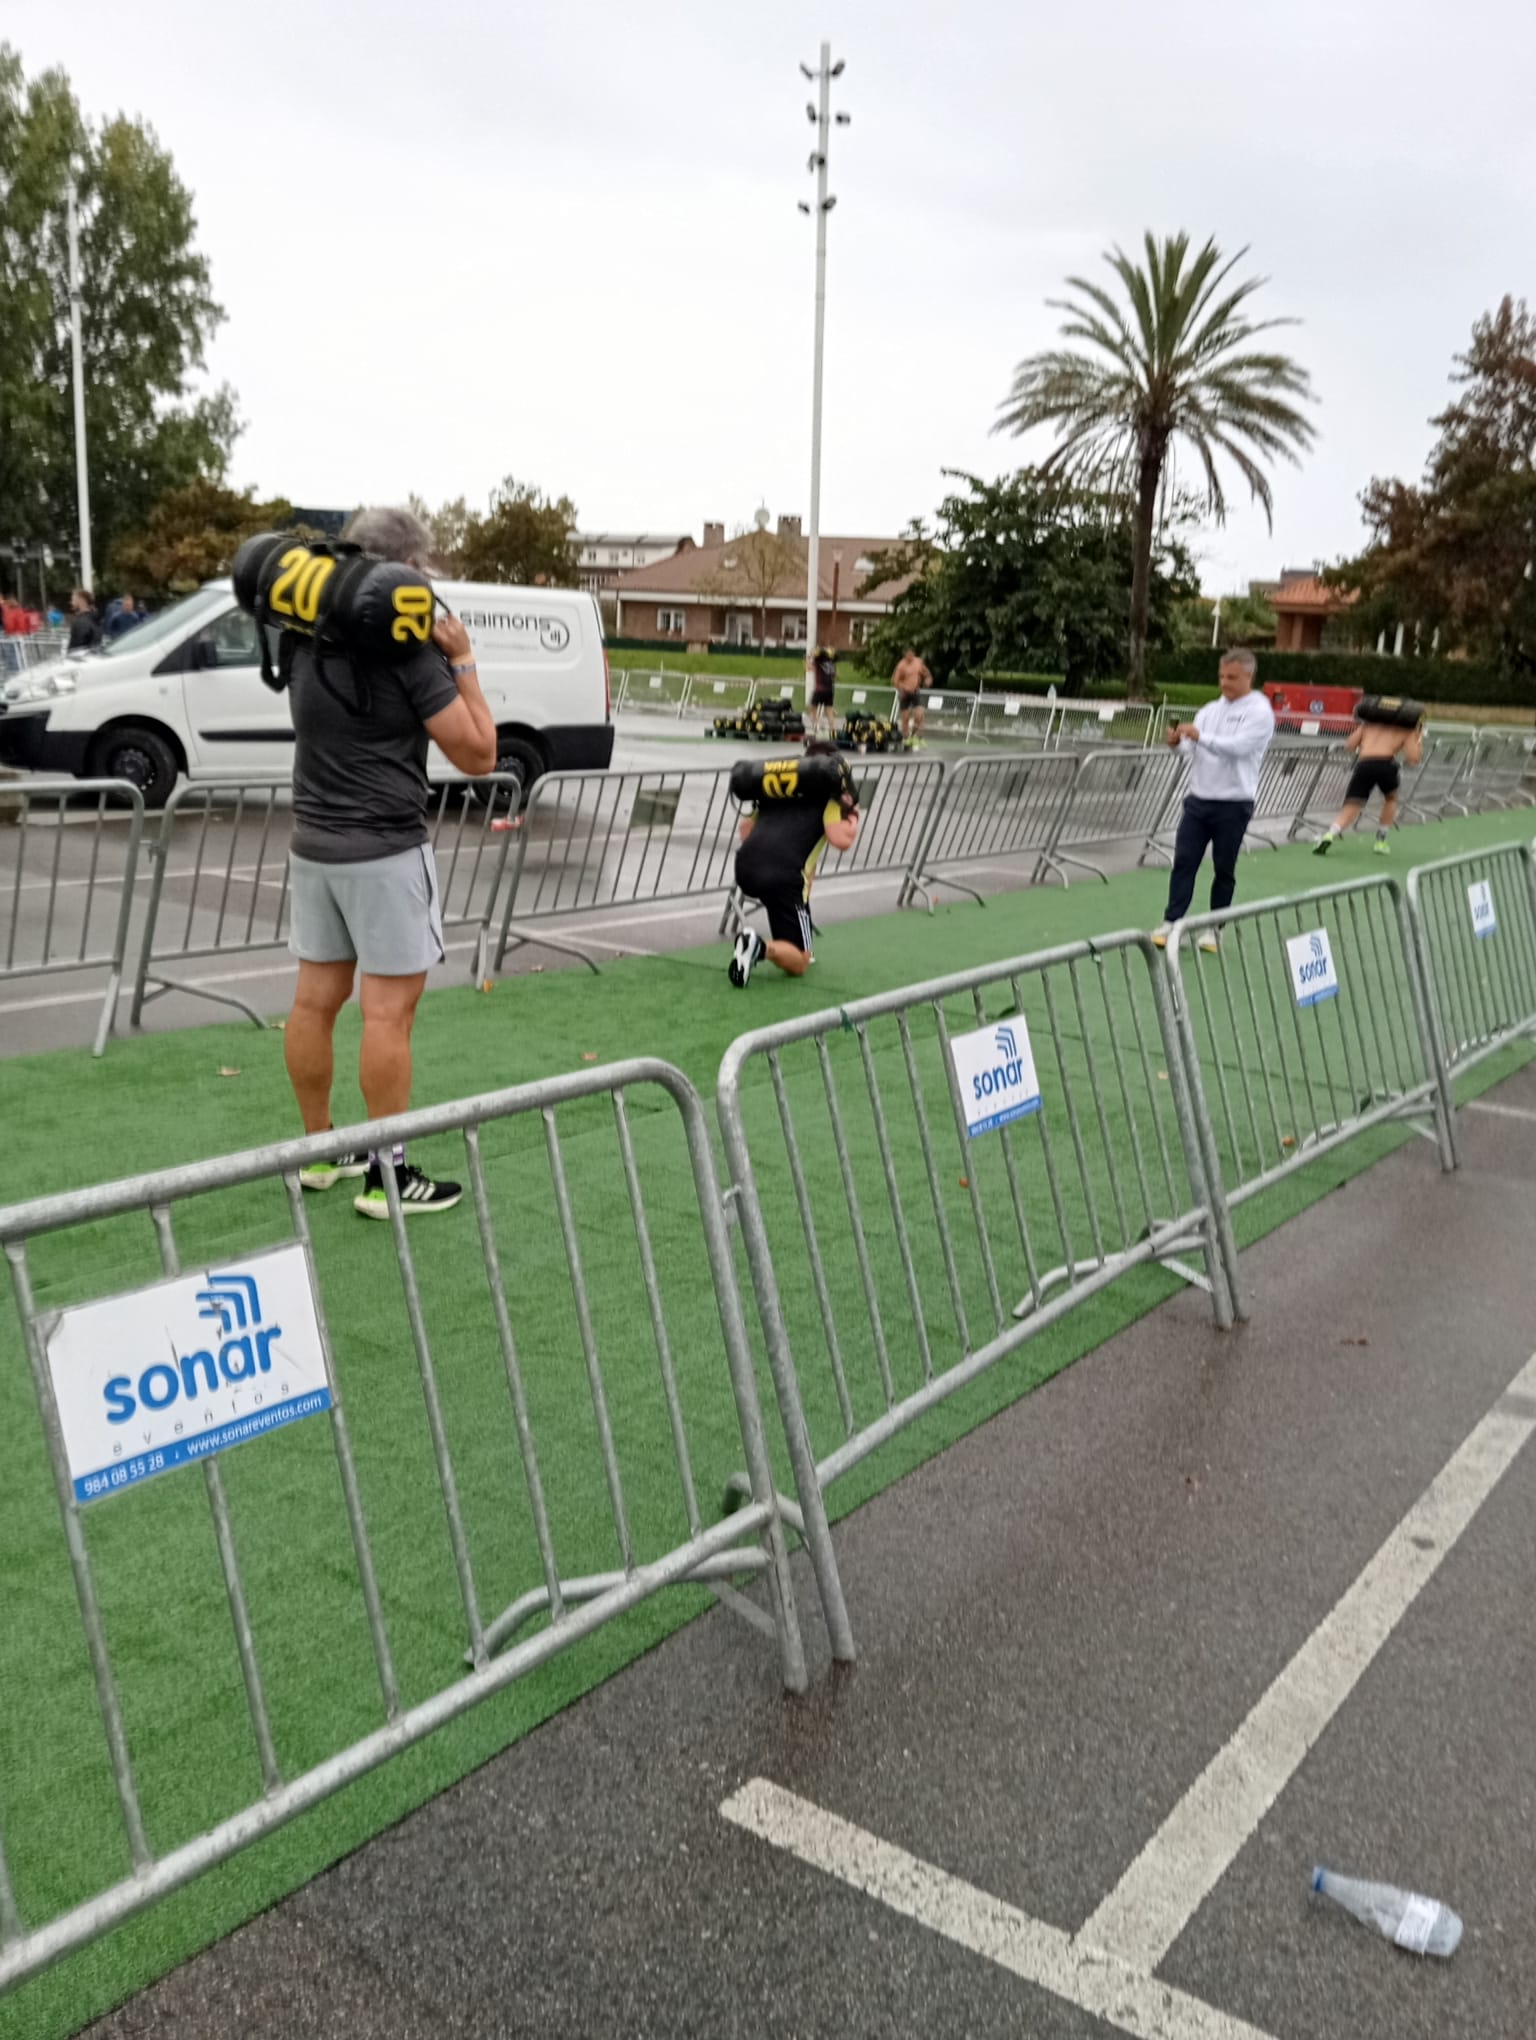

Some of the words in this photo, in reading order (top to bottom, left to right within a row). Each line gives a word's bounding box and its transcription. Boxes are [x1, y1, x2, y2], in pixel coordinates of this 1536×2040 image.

[270, 546, 335, 622] 20
[391, 585, 432, 643] 20
[1299, 957, 1327, 984] sonar
[973, 1058, 1024, 1100] sonar
[103, 1326, 282, 1425] sonar
[84, 1471, 109, 1497] 984
[111, 1465, 128, 1485] 08
[129, 1458, 145, 1479] 55
[148, 1452, 164, 1472] 28
[187, 1396, 322, 1455] www.sonareventos.com
